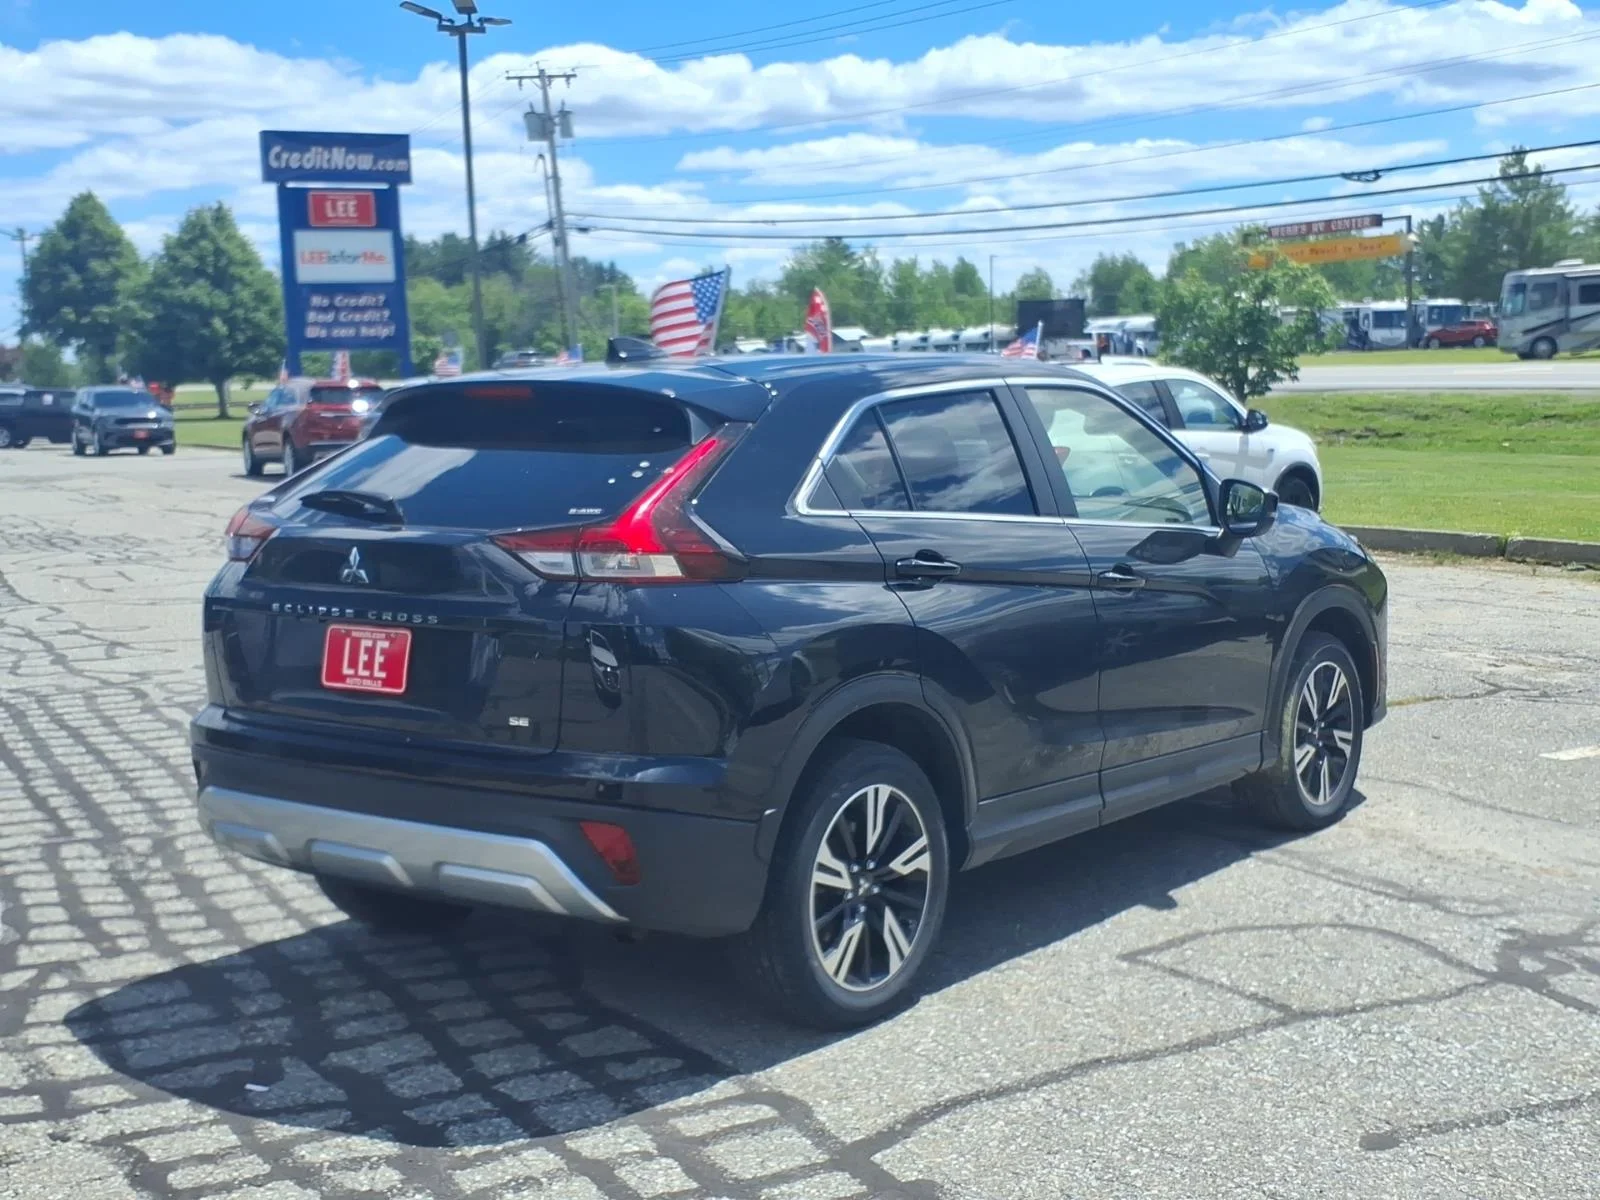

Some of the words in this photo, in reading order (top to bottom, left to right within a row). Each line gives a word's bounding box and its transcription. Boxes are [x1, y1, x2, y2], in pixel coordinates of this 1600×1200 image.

[268, 146, 409, 172] CreditNow.com
[325, 199, 358, 217] LEE
[311, 295, 329, 307] No
[334, 294, 385, 307] Credit?
[307, 311, 335, 323] Bad
[339, 309, 390, 322] Credit?
[306, 327, 328, 338] We
[331, 327, 357, 338] can
[272, 602, 355, 618] ECLIPSE
[367, 610, 439, 624] CROSS
[342, 637, 390, 678] LEE
[508, 715, 530, 727] SE
